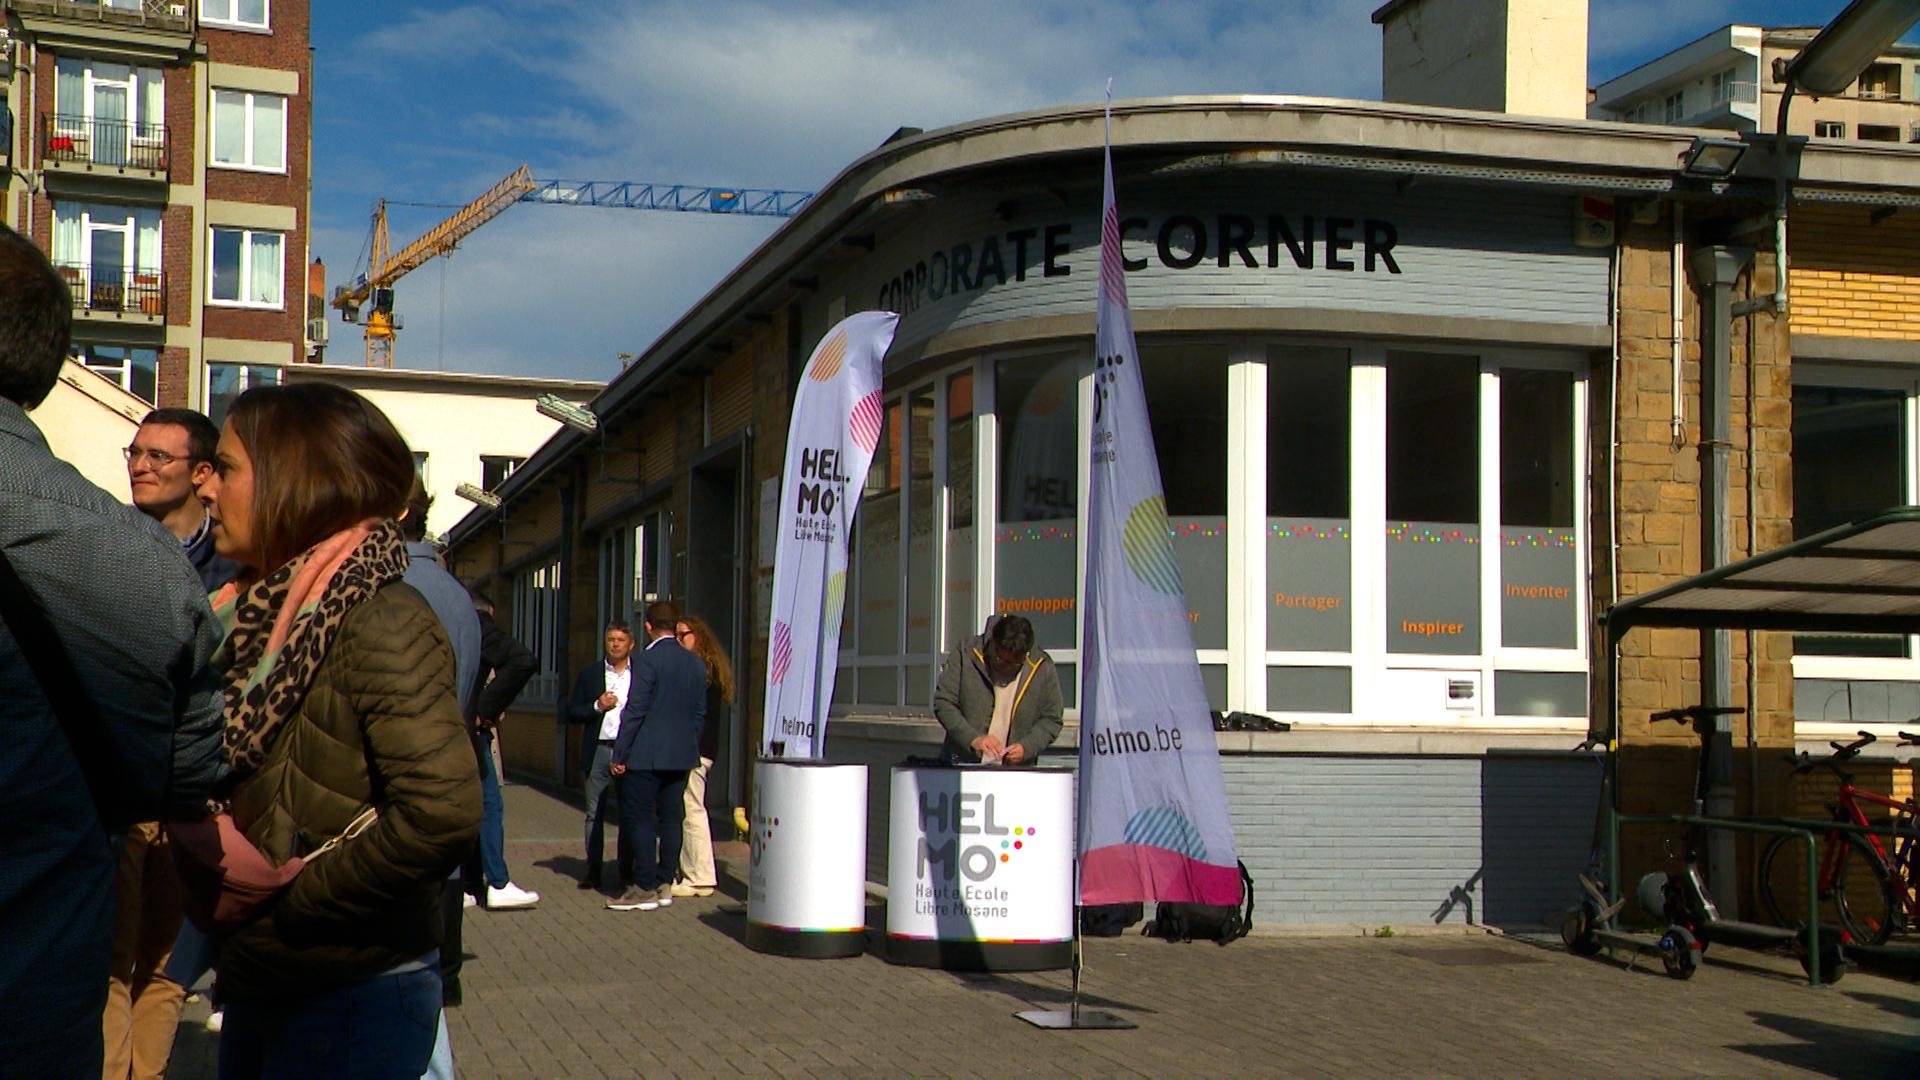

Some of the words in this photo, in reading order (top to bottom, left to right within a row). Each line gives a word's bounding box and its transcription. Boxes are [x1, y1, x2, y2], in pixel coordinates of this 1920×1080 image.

[879, 224, 1072, 317] CORPORATE
[1120, 213, 1401, 274] CORNER
[797, 482, 835, 516] MO
[1506, 583, 1571, 600] Inventer
[1275, 592, 1342, 612] Partager
[1403, 620, 1463, 636] Inspirer
[918, 791, 1009, 836] HEL
[916, 837, 997, 882] MO
[916, 883, 960, 899] Haute
[965, 885, 1008, 901] Ecole
[916, 900, 949, 916] Libre
[953, 901, 1008, 917] Mosane
